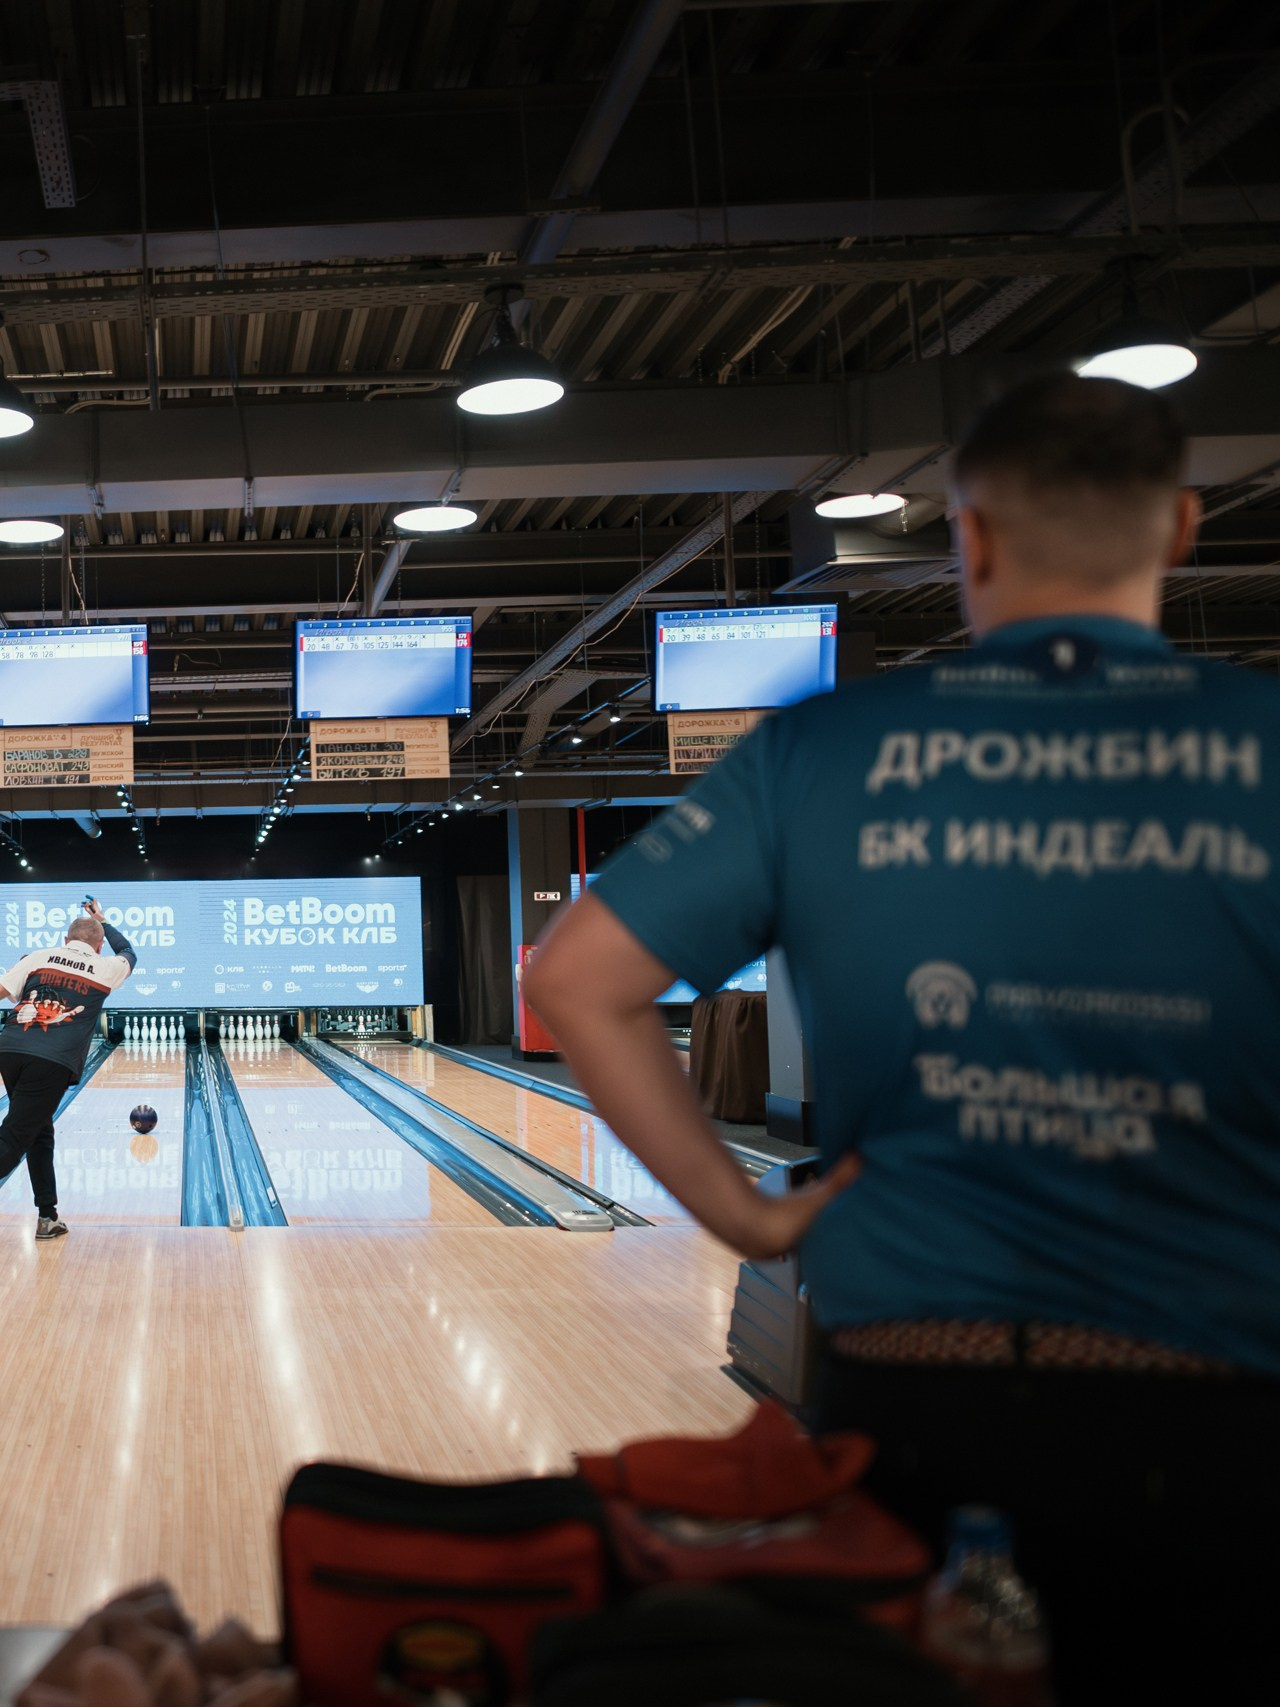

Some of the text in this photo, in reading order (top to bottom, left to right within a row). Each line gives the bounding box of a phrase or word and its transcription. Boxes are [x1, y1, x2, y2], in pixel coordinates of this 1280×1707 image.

[320, 727, 365, 735] ДОРОЖКА
[678, 719, 726, 728] ДОРОЖКА
[7, 734, 53, 743] ДОРОЖКА
[865, 730, 1261, 793] ДРОЖБИН
[91, 774, 124, 782] ДЕТСКИЙ
[858, 817, 1270, 880] БК ИНДЕАЛЬ
[26, 900, 174, 928] Betoom
[244, 897, 396, 926] BetBoom
[5, 902, 20, 948] 2024
[223, 898, 237, 946] 2024
[123, 929, 176, 947] КЛБ
[244, 926, 397, 946] КУБОК КЛБ
[325, 964, 367, 973] BetBoom
